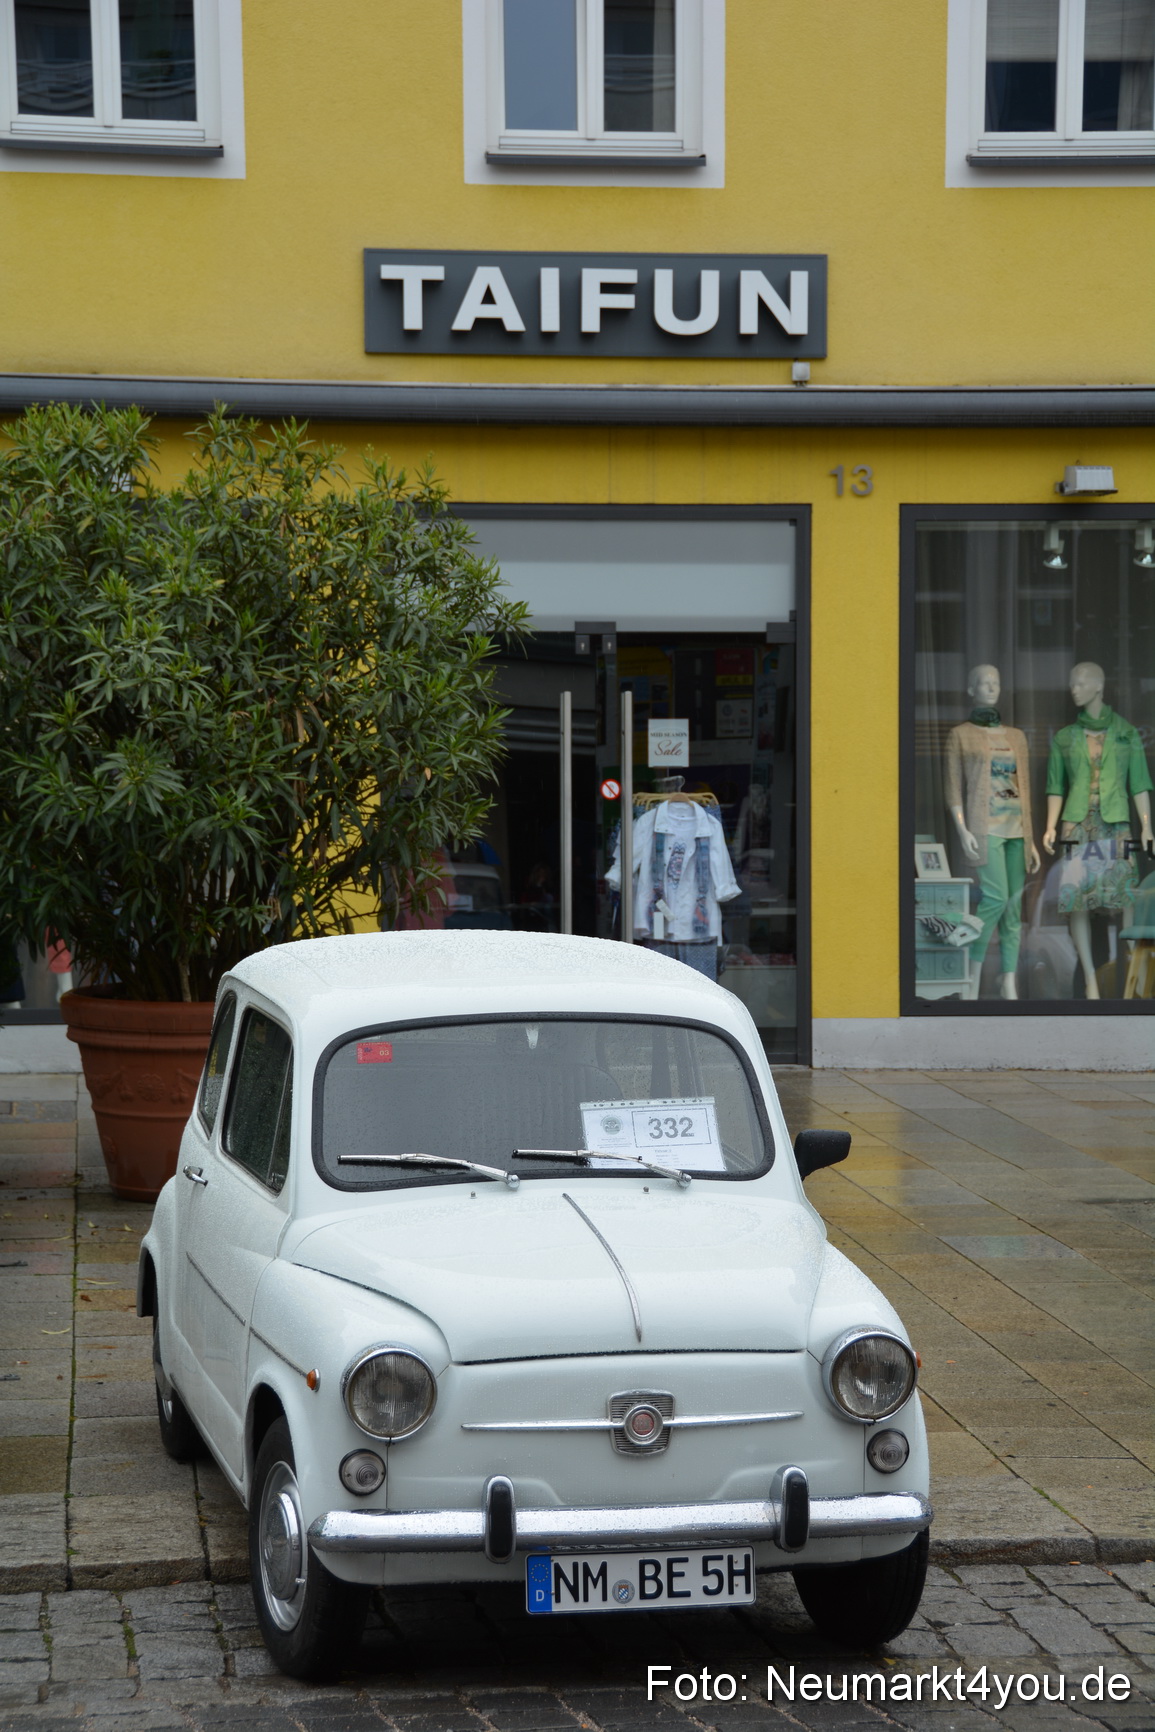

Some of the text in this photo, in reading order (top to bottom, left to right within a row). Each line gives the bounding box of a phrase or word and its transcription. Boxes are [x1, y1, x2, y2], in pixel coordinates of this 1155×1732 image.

[380, 264, 809, 336] TAIFUN
[830, 464, 874, 496] 13
[654, 740, 683, 757] Sale
[648, 1117, 694, 1139] 332
[535, 1553, 751, 1603] D NM BE 5H
